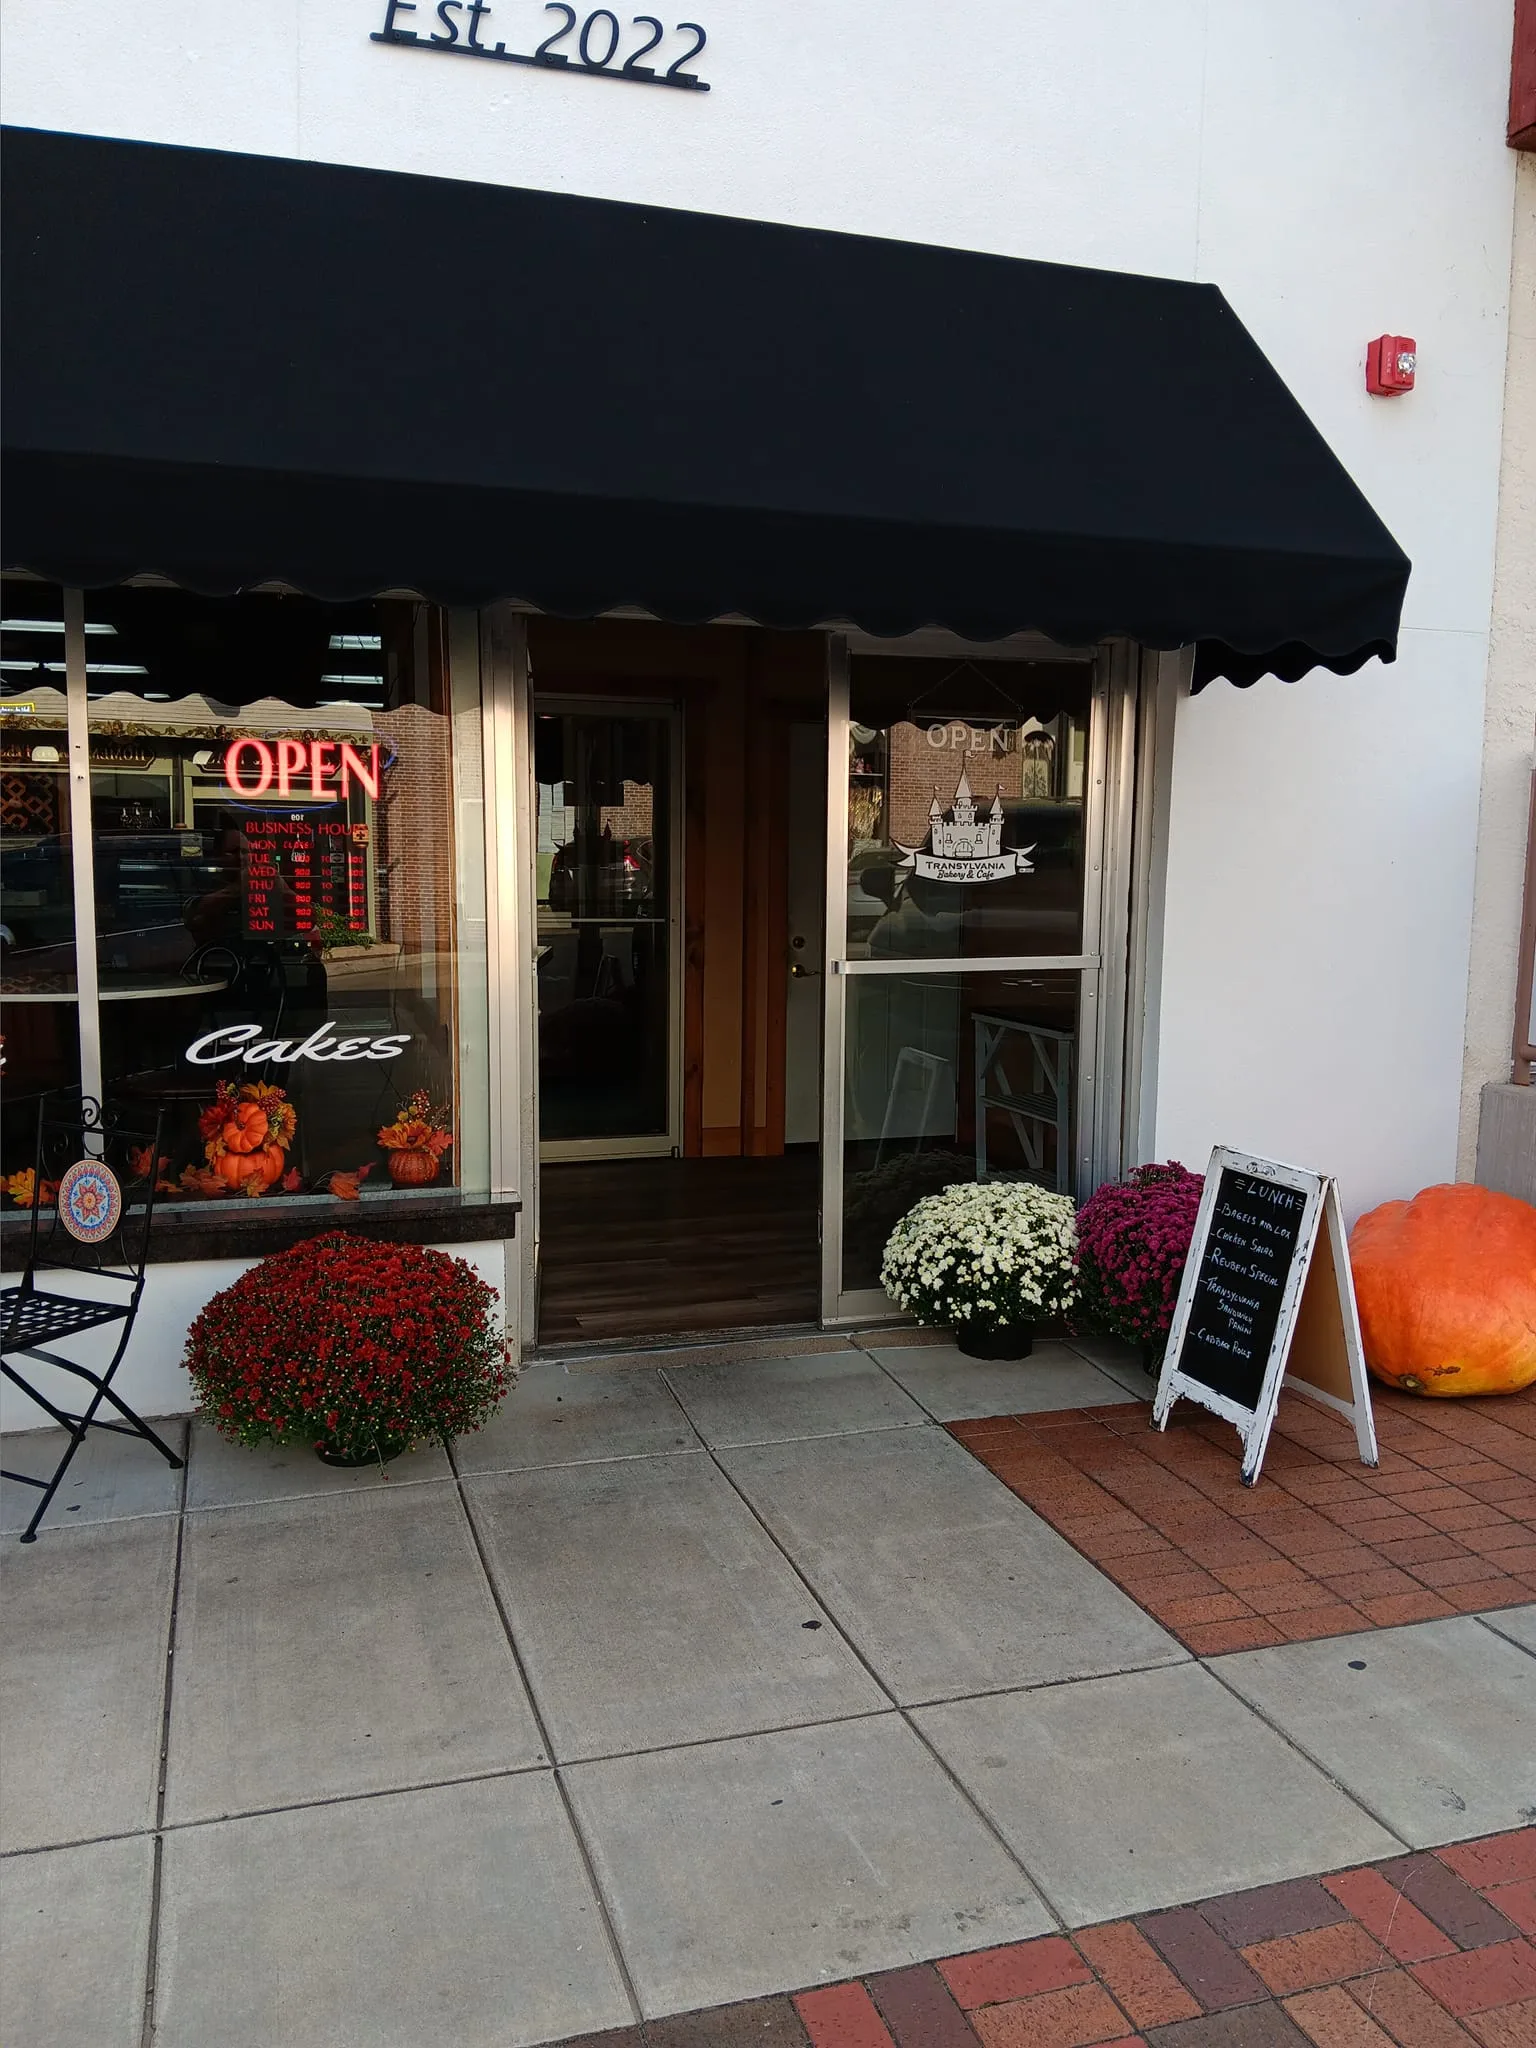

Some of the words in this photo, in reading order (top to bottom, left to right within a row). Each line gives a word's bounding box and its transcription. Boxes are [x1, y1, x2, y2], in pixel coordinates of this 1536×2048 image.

[383, 0, 506, 52] Est.
[535, 2, 707, 83] 2022
[926, 723, 1011, 752] OPEN
[224, 738, 379, 799] OPEN
[245, 822, 311, 834] BUSINESS
[248, 840, 276, 849] MON
[248, 853, 270, 863] TUE
[925, 861, 1006, 870] TRANSYLVANIA
[248, 867, 276, 876] WED
[937, 869, 966, 880] Bakery
[967, 870, 975, 879] &
[249, 881, 274, 890] THU
[248, 894, 266, 903] FRI
[248, 907, 269, 917] SAT
[249, 921, 274, 930] SUN
[185, 1022, 411, 1064] Cakes
[1247, 1181, 1295, 1209] LUNCH
[1221, 1203, 1257, 1225] BAGELS
[1273, 1226, 1291, 1239] LOX
[1250, 1238, 1274, 1258] SALAD
[1211, 1247, 1247, 1274] REUBEN
[1248, 1264, 1279, 1287] SPECIAL
